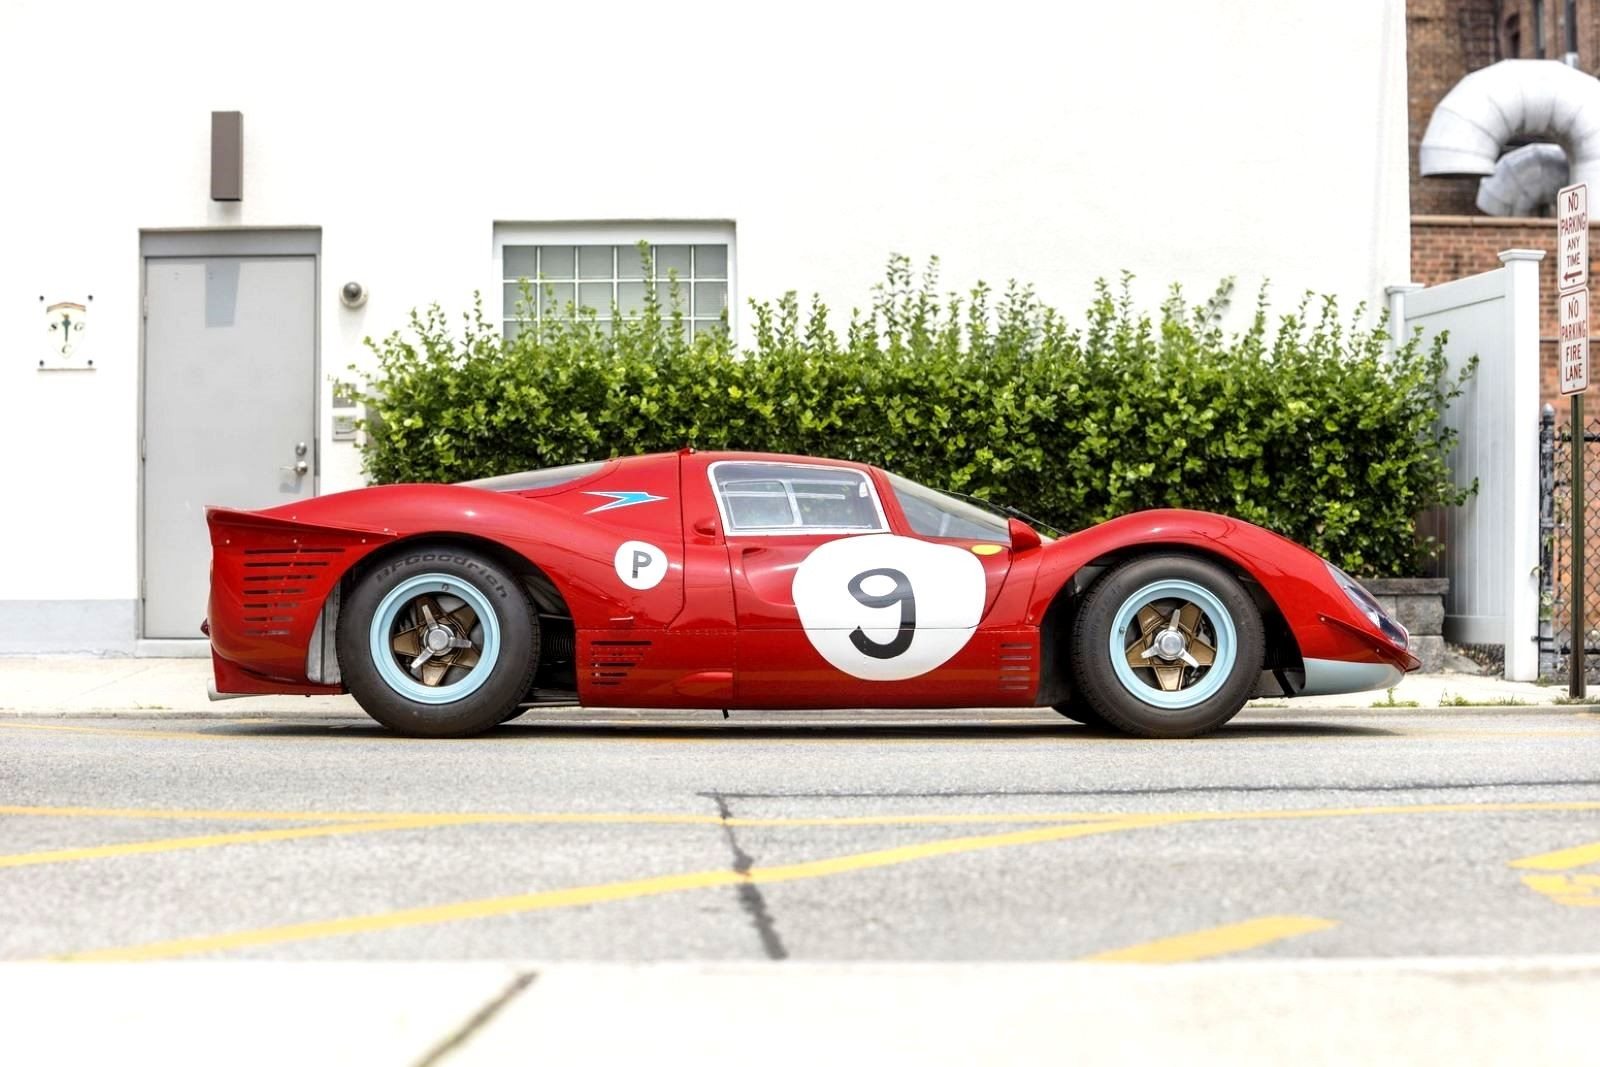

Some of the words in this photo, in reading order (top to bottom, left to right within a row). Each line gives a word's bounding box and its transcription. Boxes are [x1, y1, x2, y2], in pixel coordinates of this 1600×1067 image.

[1567, 192, 1579, 212] NO
[1561, 213, 1586, 236] PARKING
[1566, 237, 1581, 251] ANY
[1566, 252, 1581, 267] TIME
[1567, 300, 1579, 319] NO
[1561, 321, 1586, 341] PARKING
[1565, 344, 1582, 363] FIRE
[1565, 363, 1583, 382] LANE
[632, 551, 652, 579] P
[847, 568, 916, 659] 9
